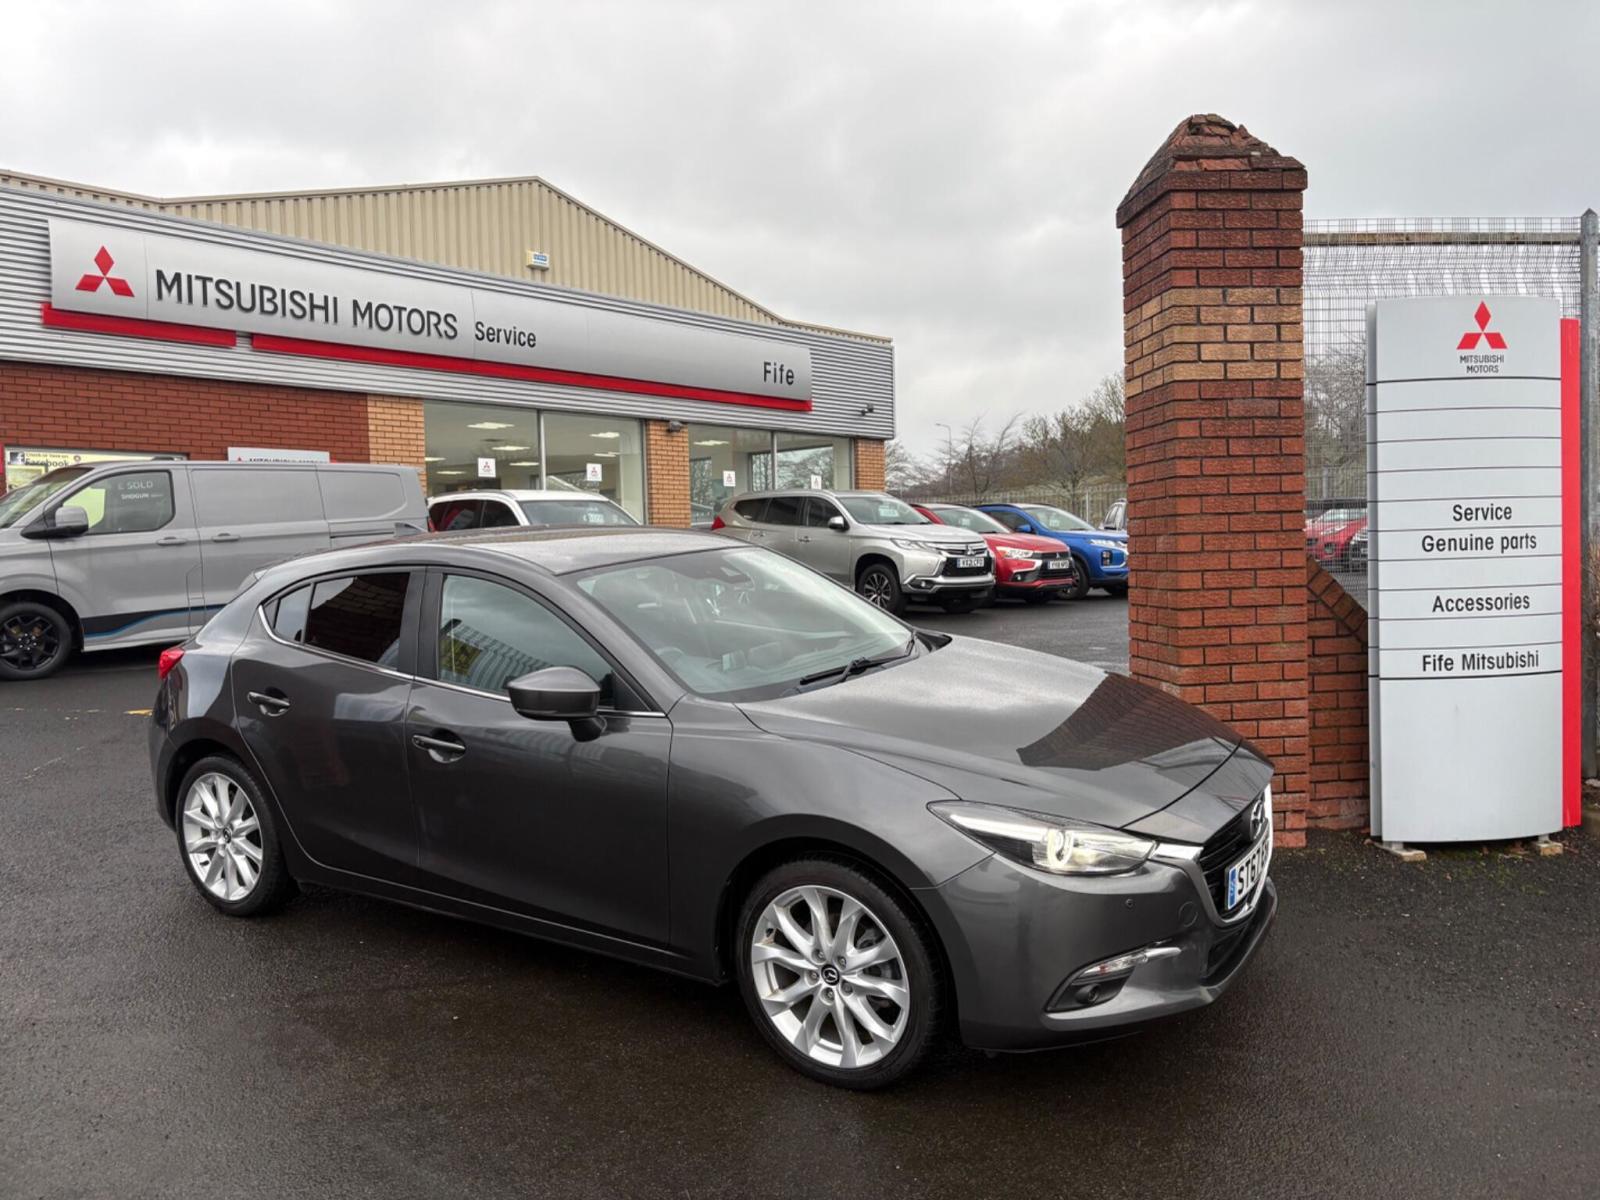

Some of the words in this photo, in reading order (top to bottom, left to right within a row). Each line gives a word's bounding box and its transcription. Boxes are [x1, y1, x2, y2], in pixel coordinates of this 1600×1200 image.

[156, 269, 338, 324] MITSUBISHI
[353, 299, 458, 340] MOTORS
[474, 321, 537, 349] Service
[1459, 354, 1505, 364] MITSUBISHI
[1466, 364, 1499, 374] MOTORS
[763, 361, 795, 386] Fife
[127, 480, 153, 490] SOLD
[1452, 503, 1512, 522] Service
[1421, 533, 1494, 553] Genuine
[1500, 533, 1537, 554] parts
[1432, 592, 1530, 613] Accessories
[1422, 654, 1454, 672] Fife
[1461, 650, 1539, 671] Mitsubishi
